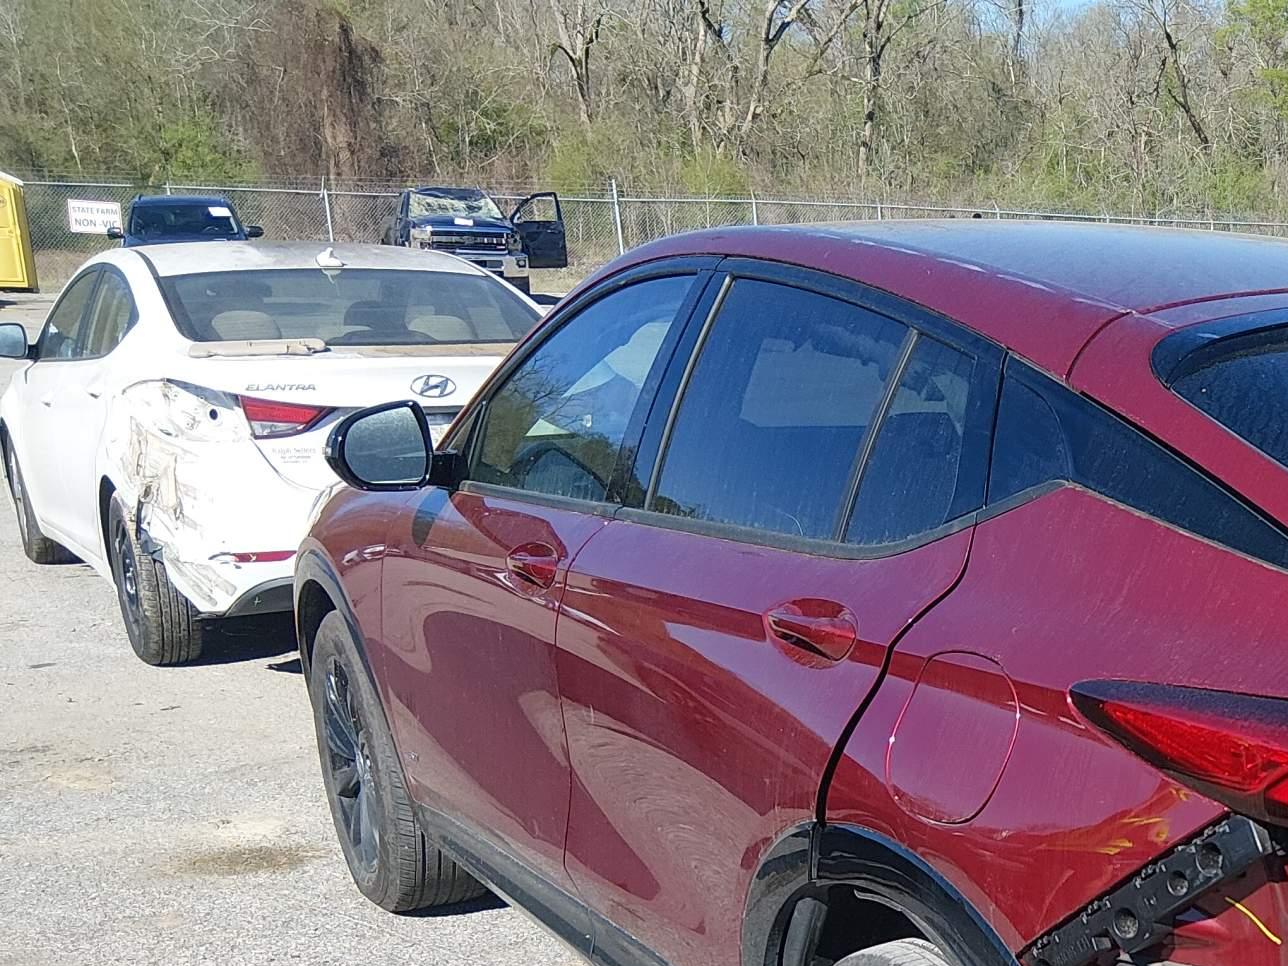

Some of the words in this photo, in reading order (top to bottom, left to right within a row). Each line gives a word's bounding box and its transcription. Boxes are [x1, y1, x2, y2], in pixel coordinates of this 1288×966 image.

[72, 206, 95, 215] STATE
[96, 207, 118, 216] FARM
[74, 217, 97, 227] NON
[245, 383, 317, 392] ELANTRA
